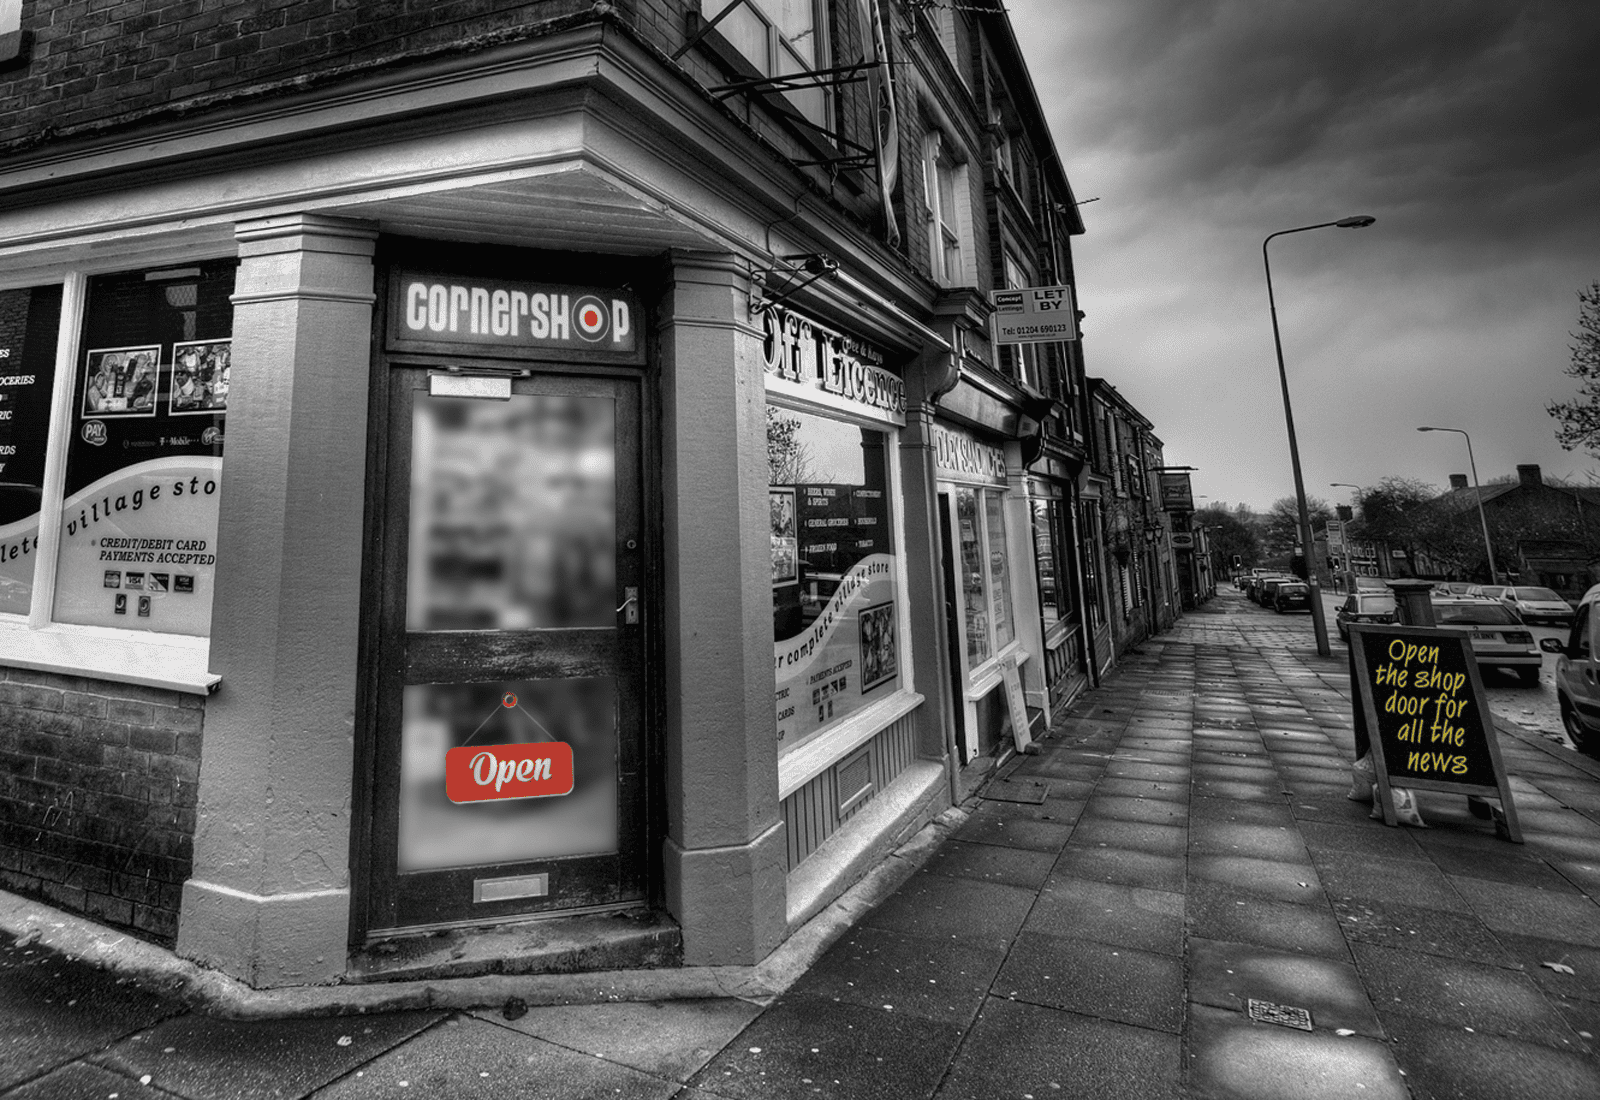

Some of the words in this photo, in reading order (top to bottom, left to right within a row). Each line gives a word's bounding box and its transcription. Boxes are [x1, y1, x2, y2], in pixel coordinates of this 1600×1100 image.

[998, 295, 1021, 303] Concept
[1034, 289, 1065, 300] LET
[1040, 301, 1062, 310] BY
[1002, 327, 1016, 335] Tel:
[1016, 326, 1039, 335] 01204
[1040, 324, 1067, 333] 690123
[67, 484, 160, 536] village
[100, 537, 173, 550] CREDIT/DEBIT
[175, 540, 207, 551] CARD
[100, 550, 155, 563] PAYMENTS
[156, 552, 216, 565] ACCEPTED
[787, 612, 833, 665] complete
[868, 561, 888, 576] store
[1389, 639, 1440, 668] Open
[1375, 662, 1409, 688] the
[1414, 665, 1466, 697] shop
[1384, 690, 1430, 716] door
[1434, 693, 1468, 724] for
[1397, 718, 1424, 744] all
[1430, 718, 1465, 747] the
[468, 751, 553, 793] Open
[1407, 751, 1469, 775] news
